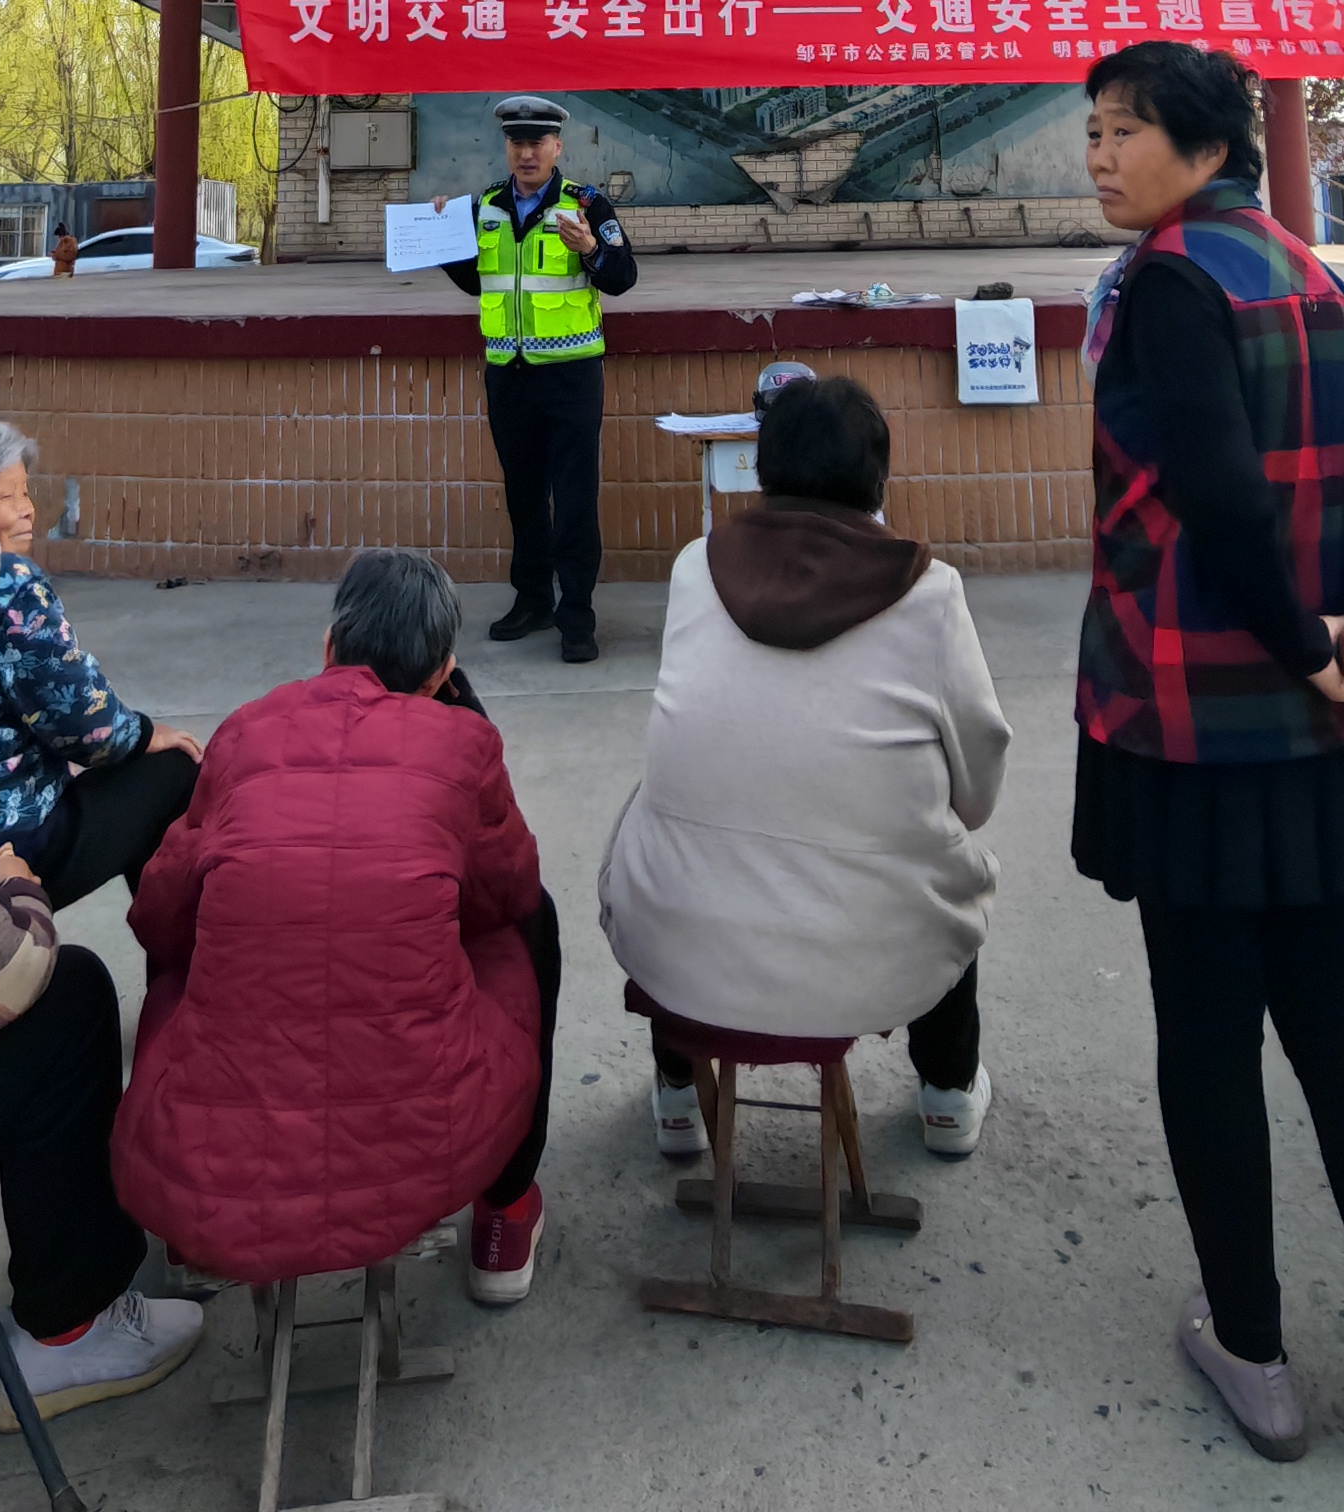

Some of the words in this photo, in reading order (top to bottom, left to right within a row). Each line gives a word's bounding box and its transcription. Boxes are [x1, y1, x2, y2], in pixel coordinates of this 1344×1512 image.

[796, 40, 1023, 64] 邹平市公安局交管大队
